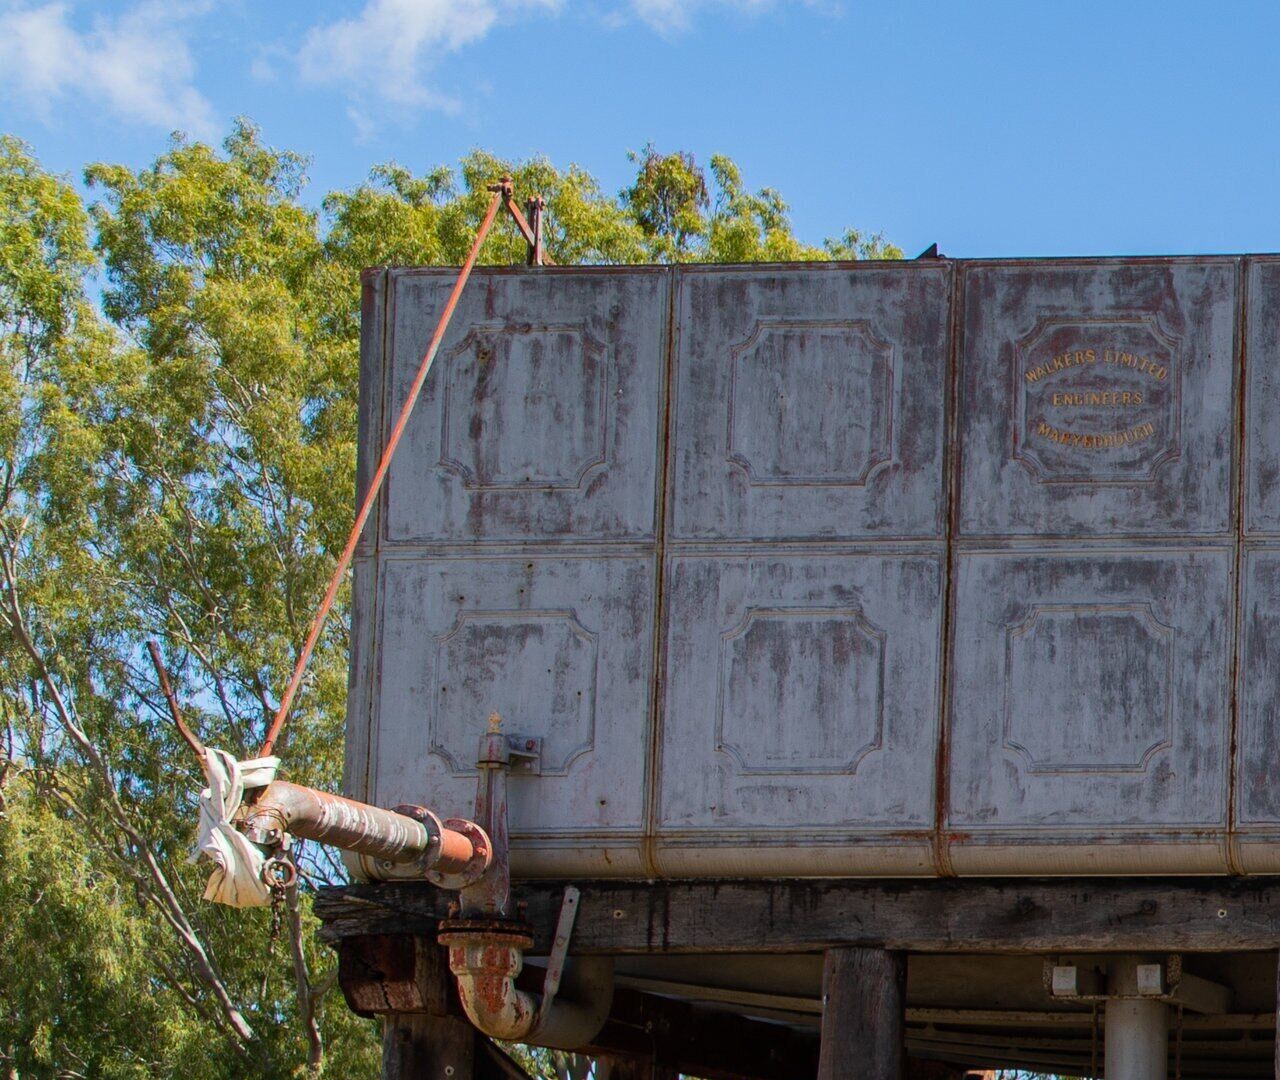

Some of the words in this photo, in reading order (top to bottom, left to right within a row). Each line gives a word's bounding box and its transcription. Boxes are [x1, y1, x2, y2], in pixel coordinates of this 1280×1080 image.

[1025, 349, 1096, 382] WALKERS
[1104, 350, 1168, 381] LIMITED
[1053, 391, 1143, 406] ENGINEERS
[1037, 422, 1155, 448] MARYBOROUGH
